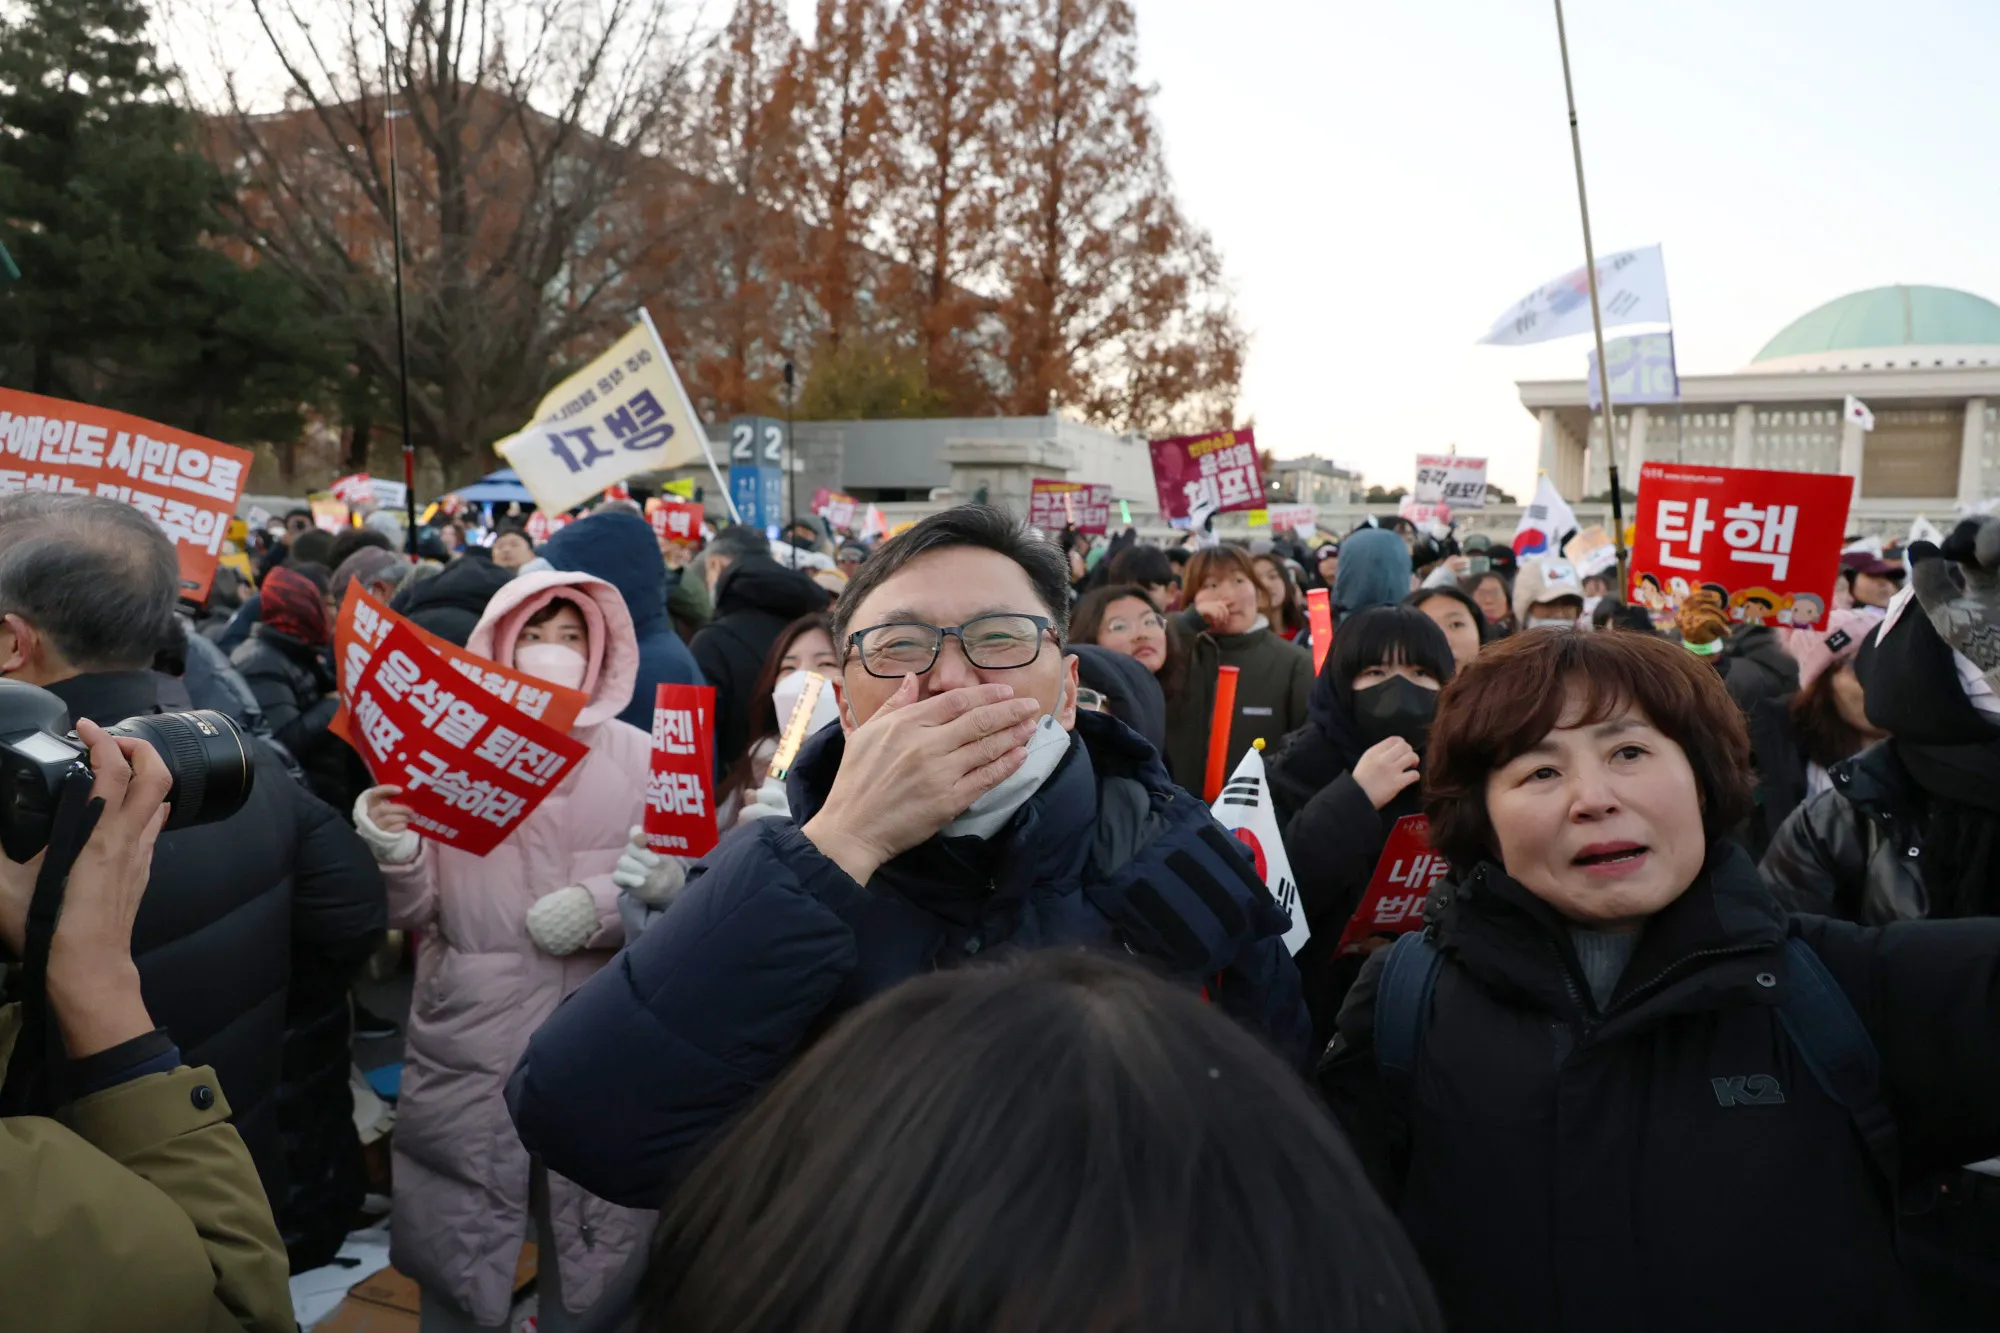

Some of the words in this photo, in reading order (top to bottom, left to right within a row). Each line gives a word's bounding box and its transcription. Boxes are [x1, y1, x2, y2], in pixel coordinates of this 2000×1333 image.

[106, 431, 243, 503] 시민으로
[733, 424, 754, 459] 2
[764, 425, 783, 460] 2
[1656, 498, 1799, 581] 탄핵
[375, 650, 488, 749] 윤석열
[474, 725, 567, 786] 퇴진!
[1711, 1074, 1786, 1107] K2
